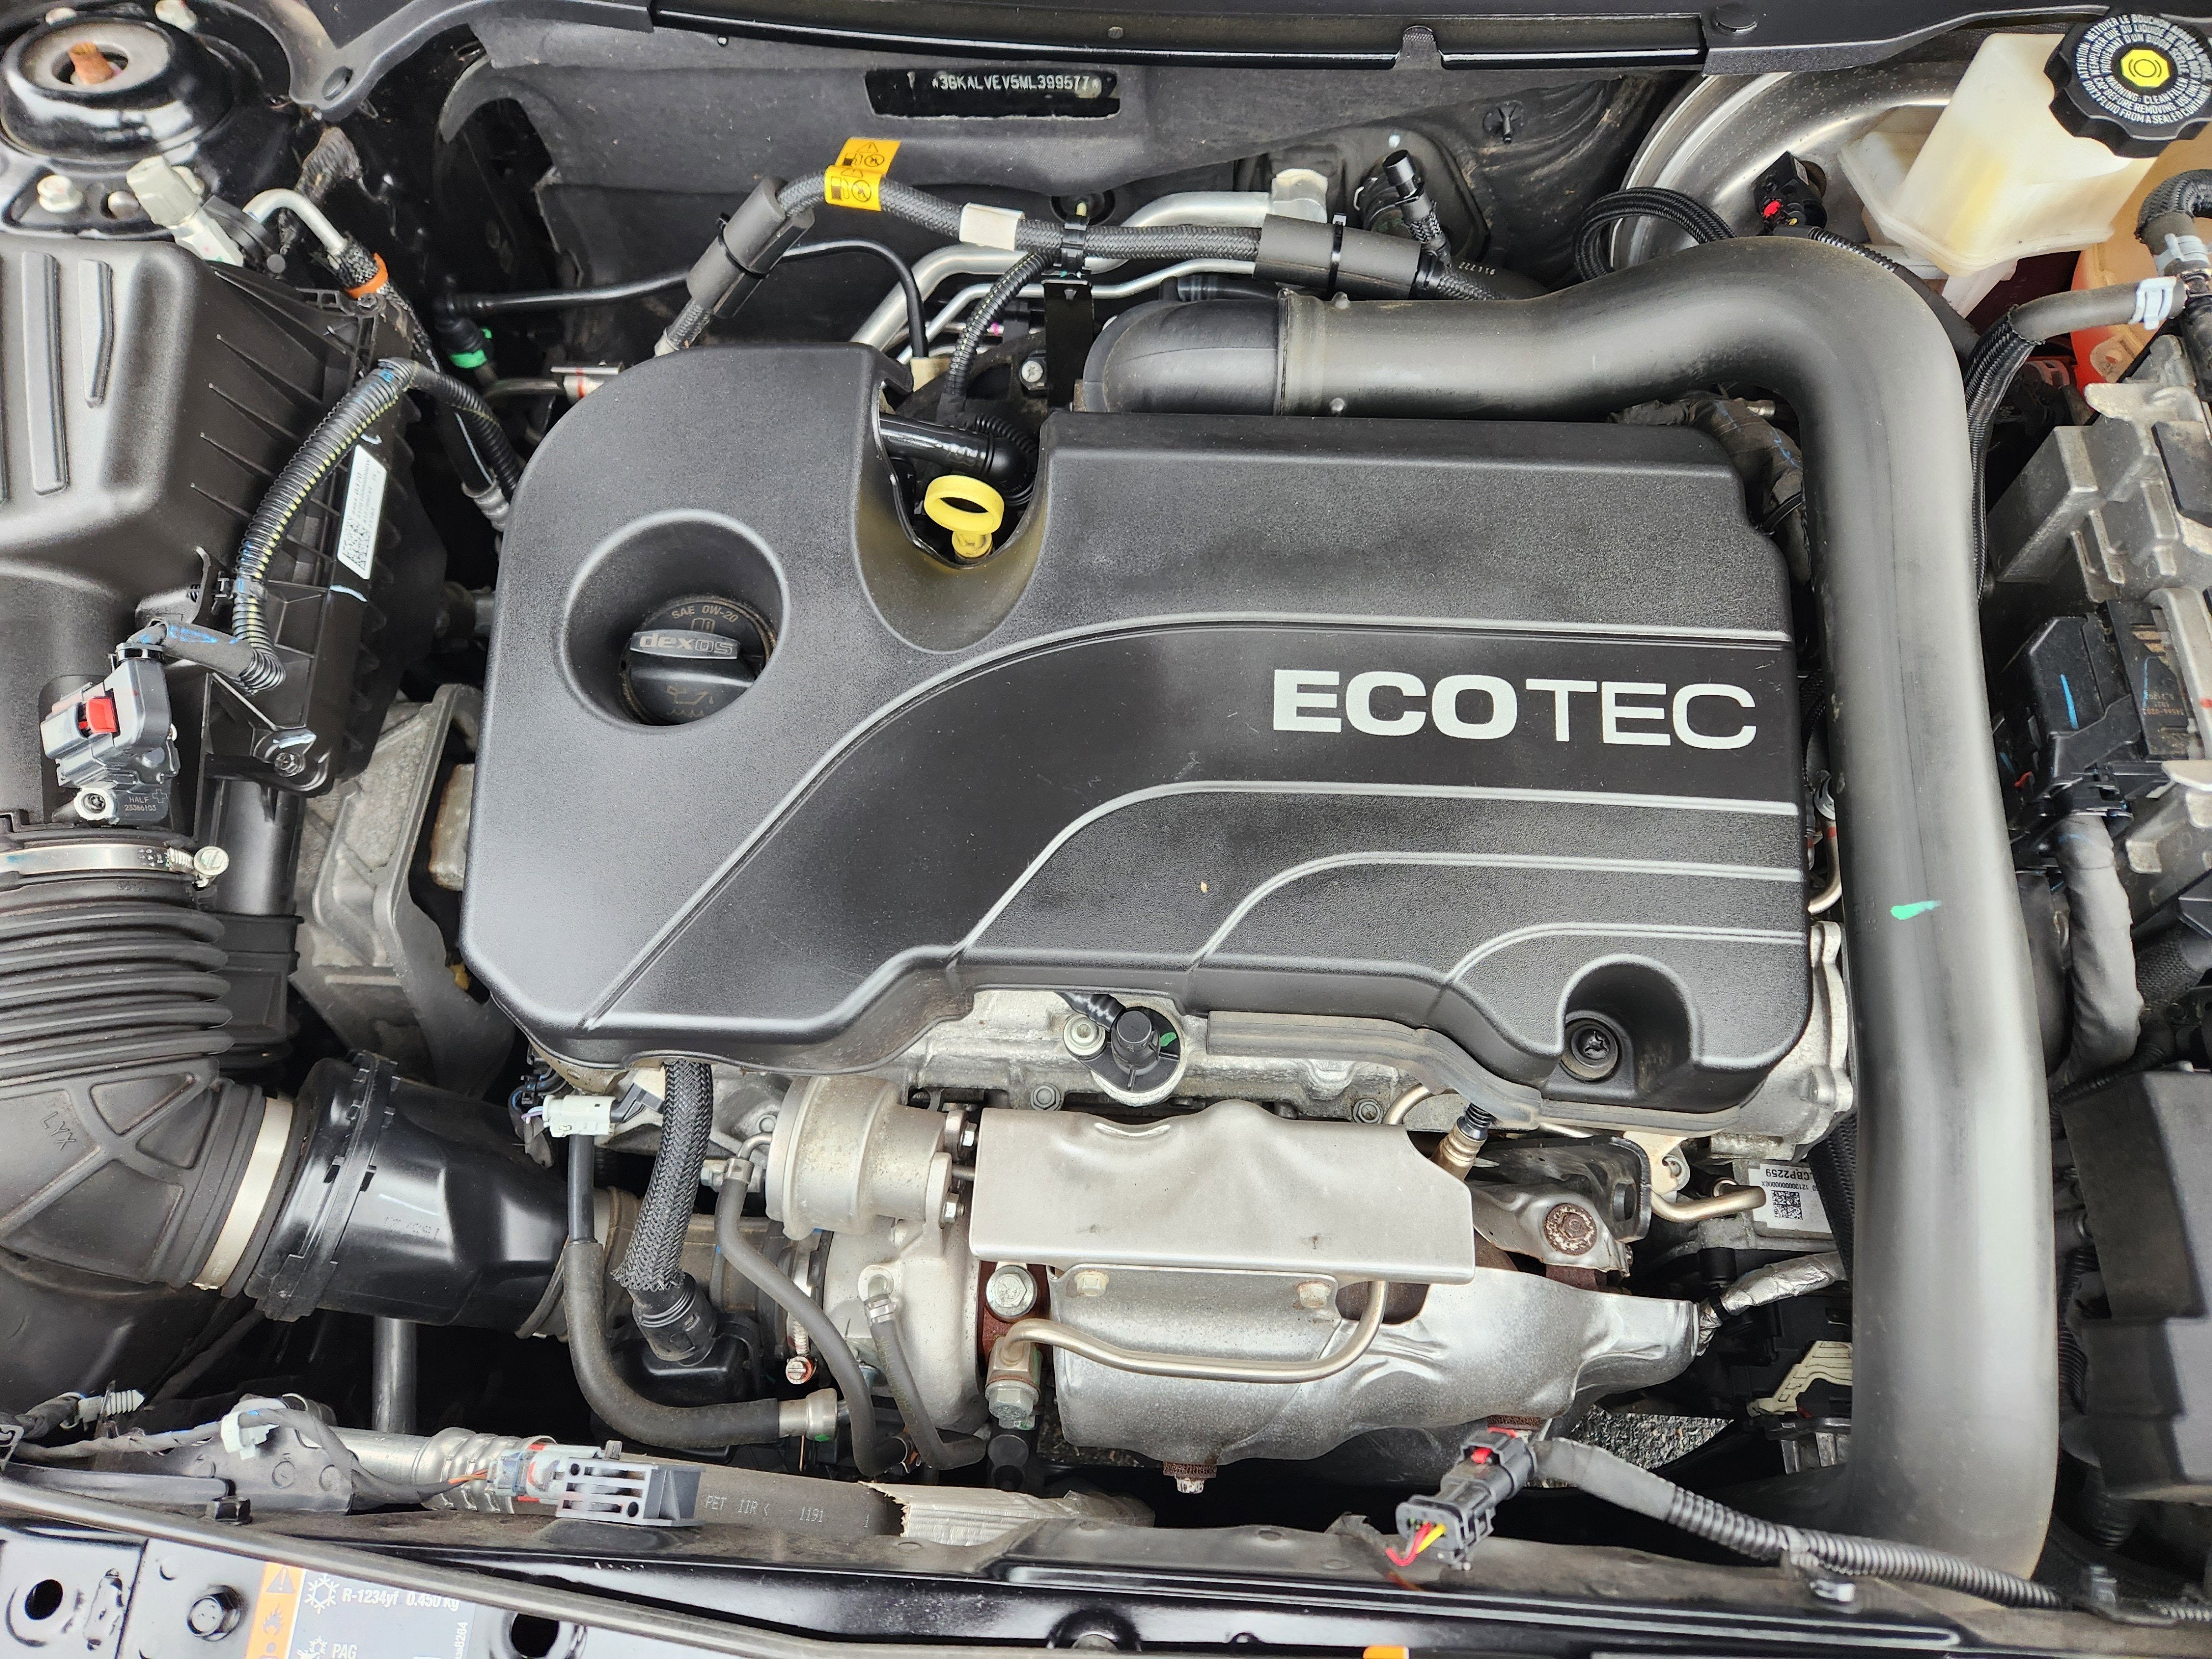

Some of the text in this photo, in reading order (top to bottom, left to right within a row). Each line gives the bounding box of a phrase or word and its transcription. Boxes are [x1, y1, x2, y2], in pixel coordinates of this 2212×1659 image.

[2083, 17, 2119, 41] NETTOYER
[2117, 14, 2130, 24] LE
[2130, 14, 2171, 30] BOUCHON
[2103, 27, 2121, 40] QUE
[2119, 24, 2133, 34] DU
[2133, 24, 2166, 38] LIQUIDE
[2100, 36, 2125, 74] PROVENANT
[2121, 33, 2143, 44] D'UN
[2145, 34, 2173, 51] BIDON
[2093, 76, 2109, 91] CAP
[2103, 87, 2133, 109] BEFORE
[2174, 93, 2192, 107] USE
[2103, 75, 2142, 102] WARNING:
[2142, 92, 2172, 103] CLEAN
[2095, 95, 2121, 114] FLUID
[2118, 108, 2143, 123] FROM
[2145, 114, 2151, 123] A
[2151, 109, 2184, 123] SEALED
[671, 605, 739, 623] SAE 0W-20
[639, 633, 733, 655] dexos
[1273, 670, 1757, 749] ECOTEC
[342, 1588, 400, 1608] R-1234yf
[332, 1644, 358, 1659] PAG
